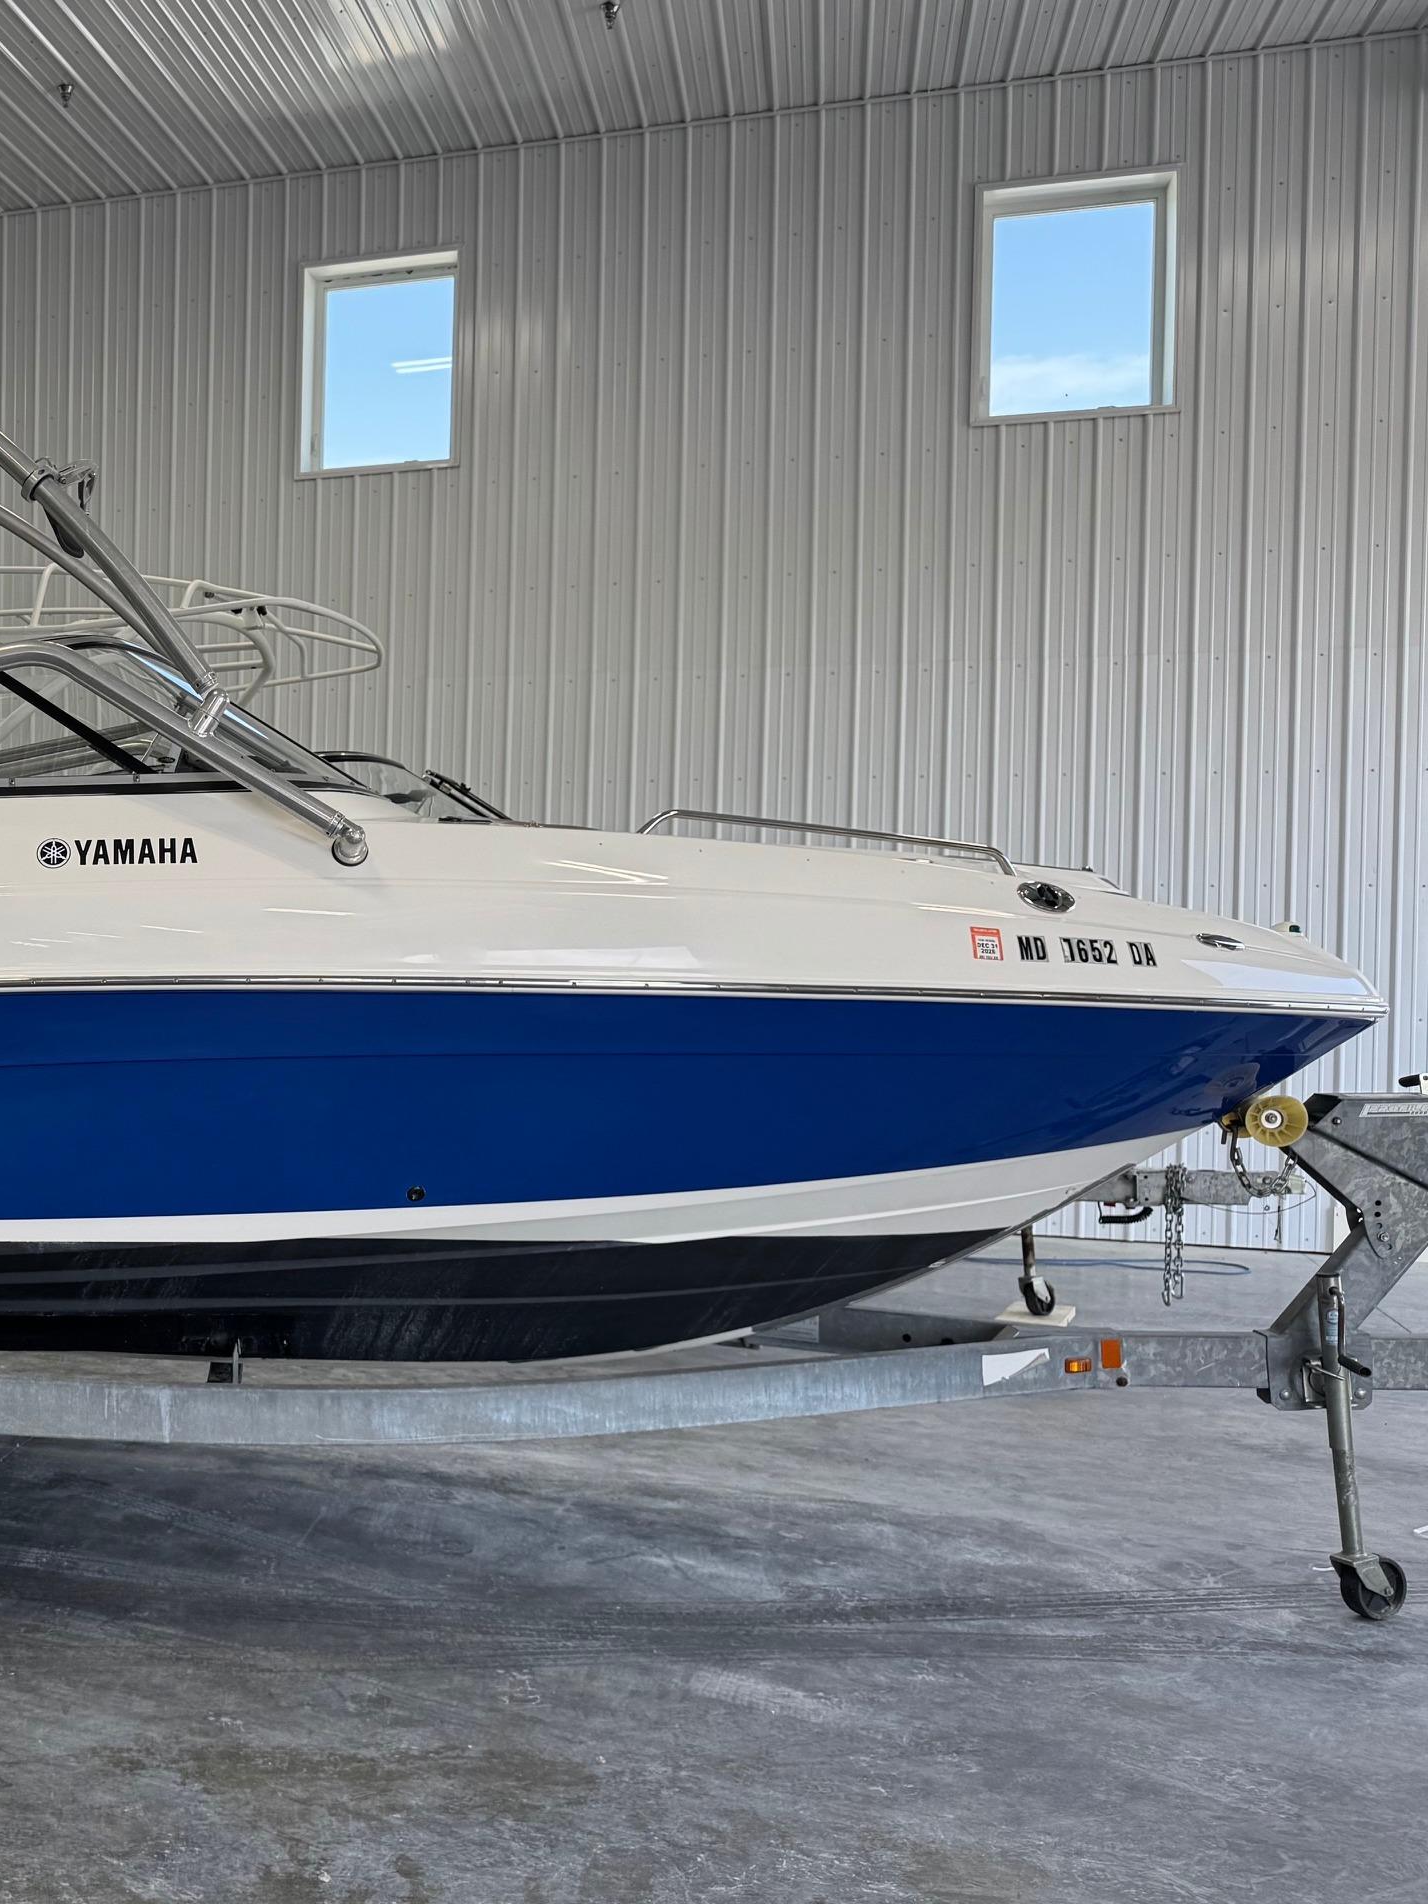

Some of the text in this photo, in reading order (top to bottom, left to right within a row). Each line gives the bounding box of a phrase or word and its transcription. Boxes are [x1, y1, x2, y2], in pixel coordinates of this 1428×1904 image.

[74, 837, 198, 866] YAMAHA
[1017, 935, 1157, 967] MD 7652 DA
